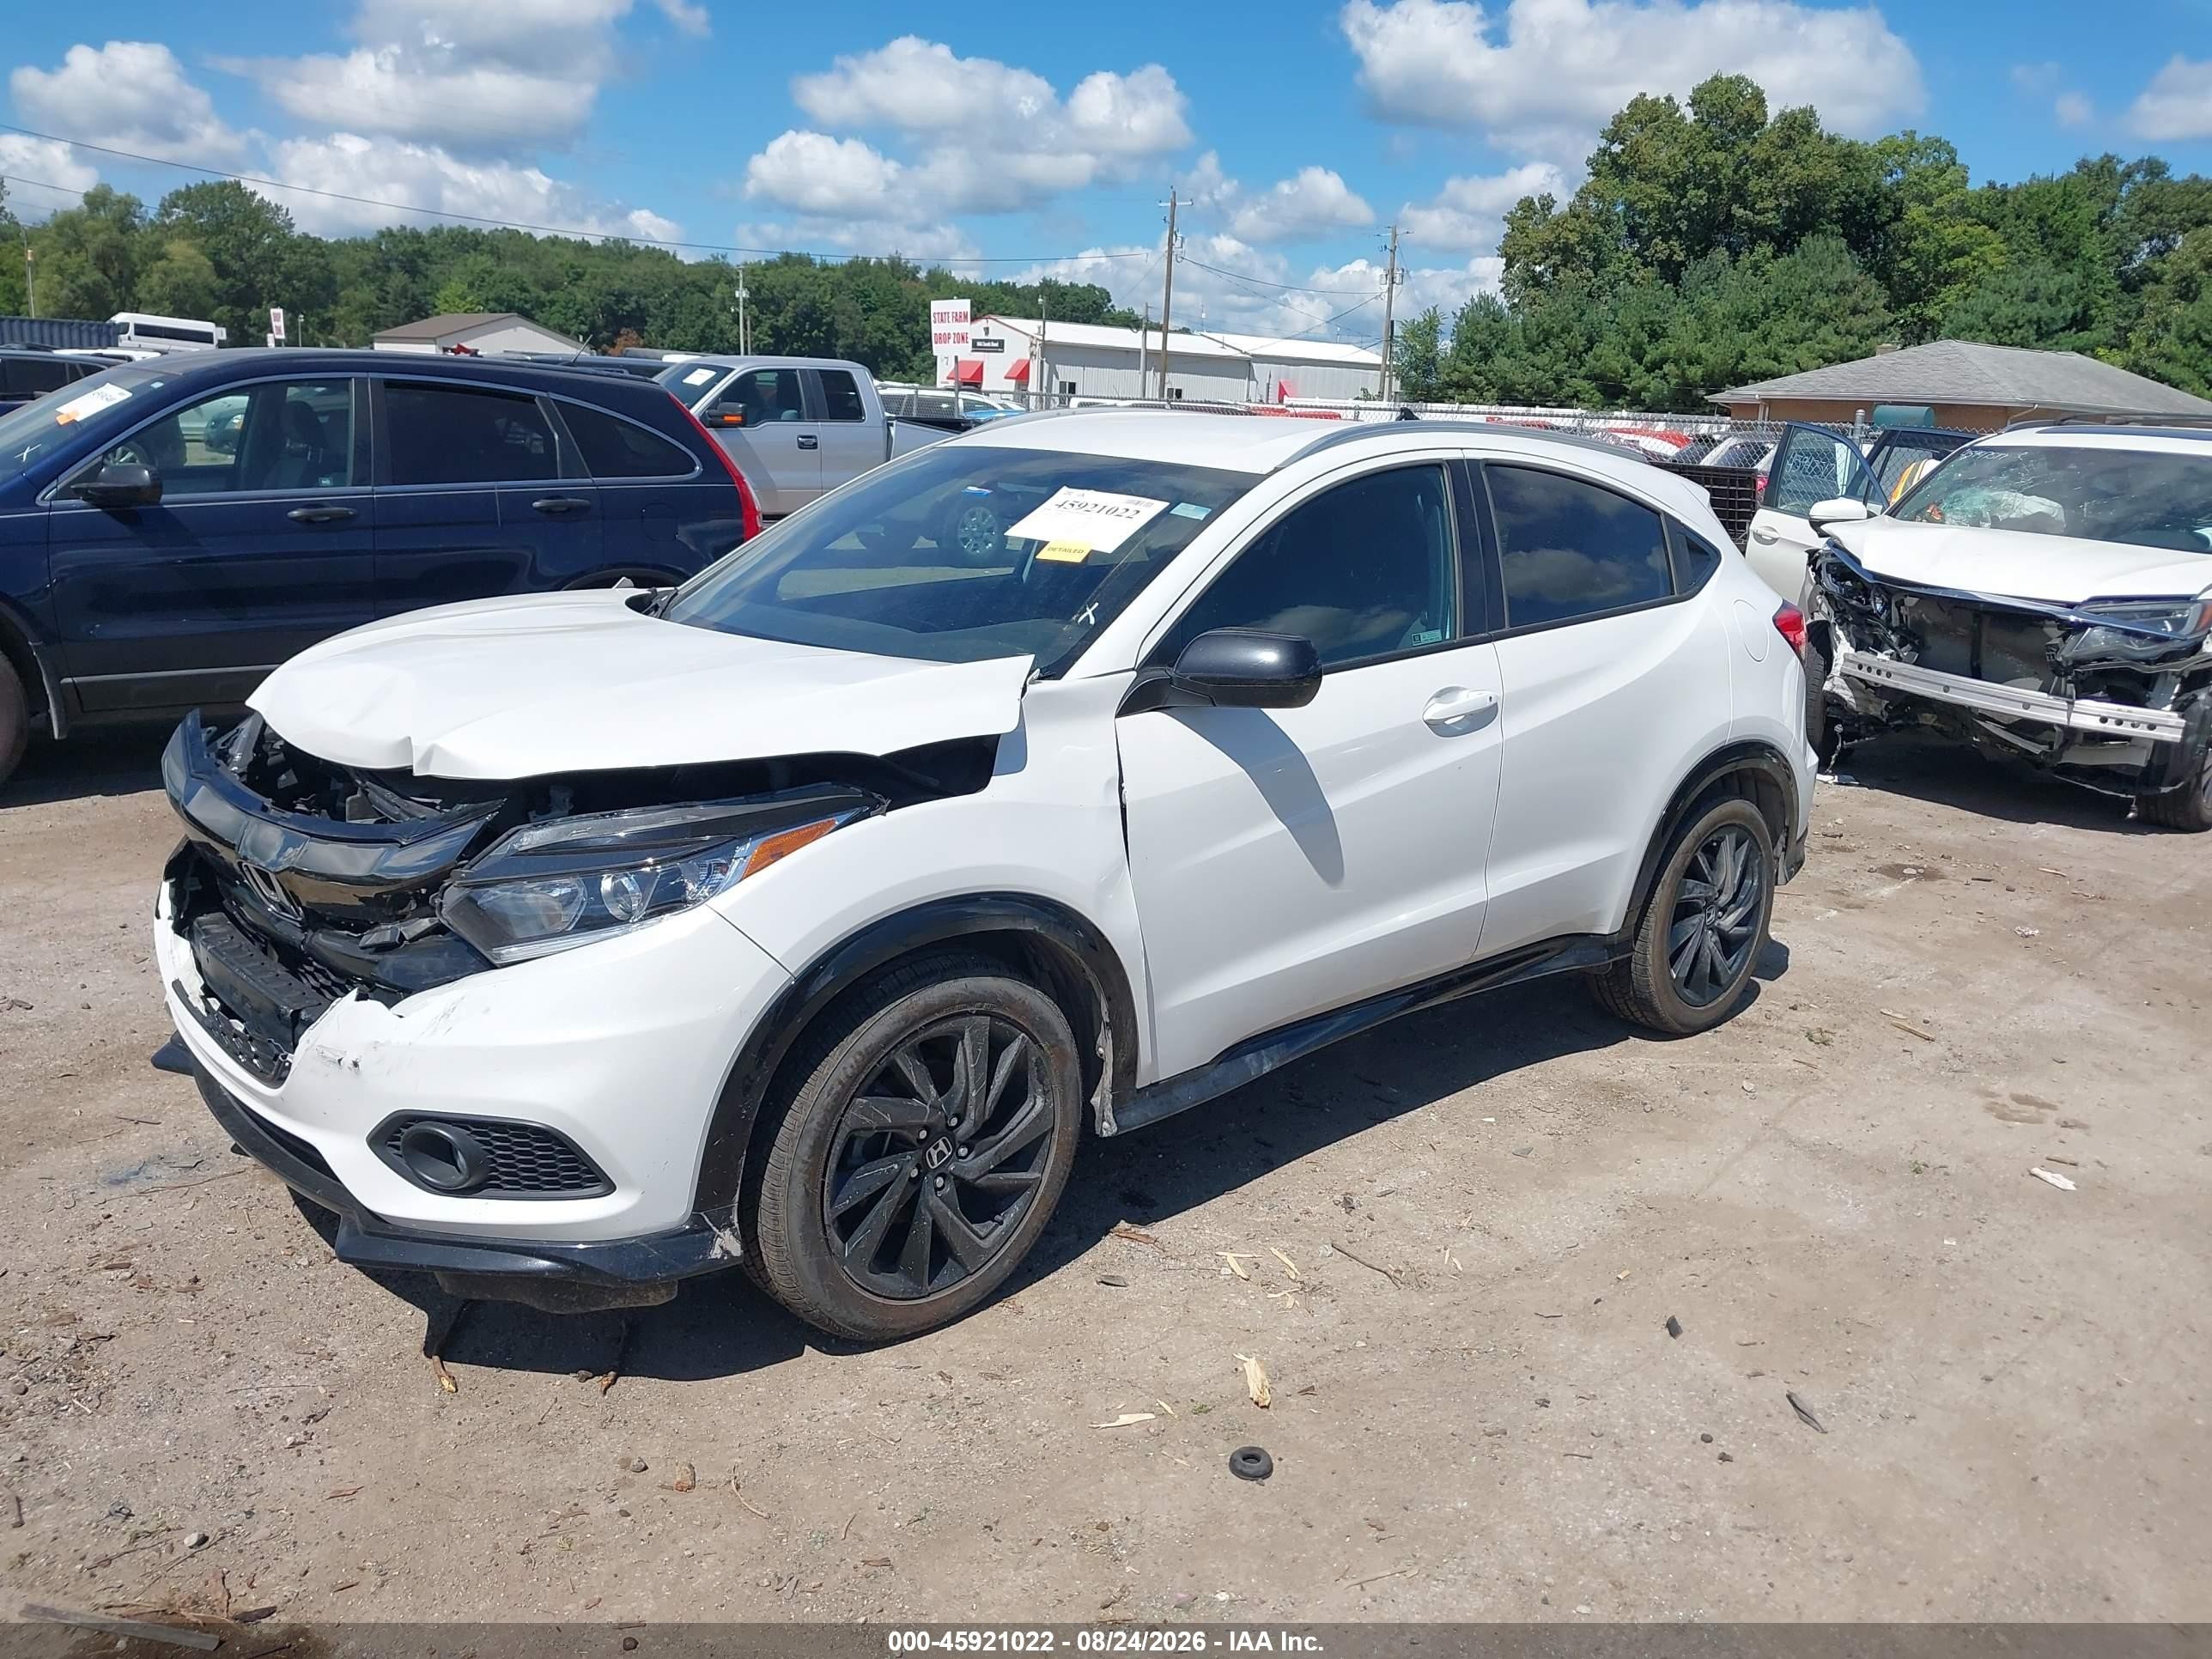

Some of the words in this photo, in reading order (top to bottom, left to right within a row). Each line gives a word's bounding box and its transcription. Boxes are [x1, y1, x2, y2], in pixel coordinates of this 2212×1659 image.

[933, 311, 950, 324] STATE
[951, 311, 969, 324] FARM
[933, 331, 951, 344] DROP
[952, 331, 969, 344] ZONE
[1054, 500, 1141, 520] 45921022
